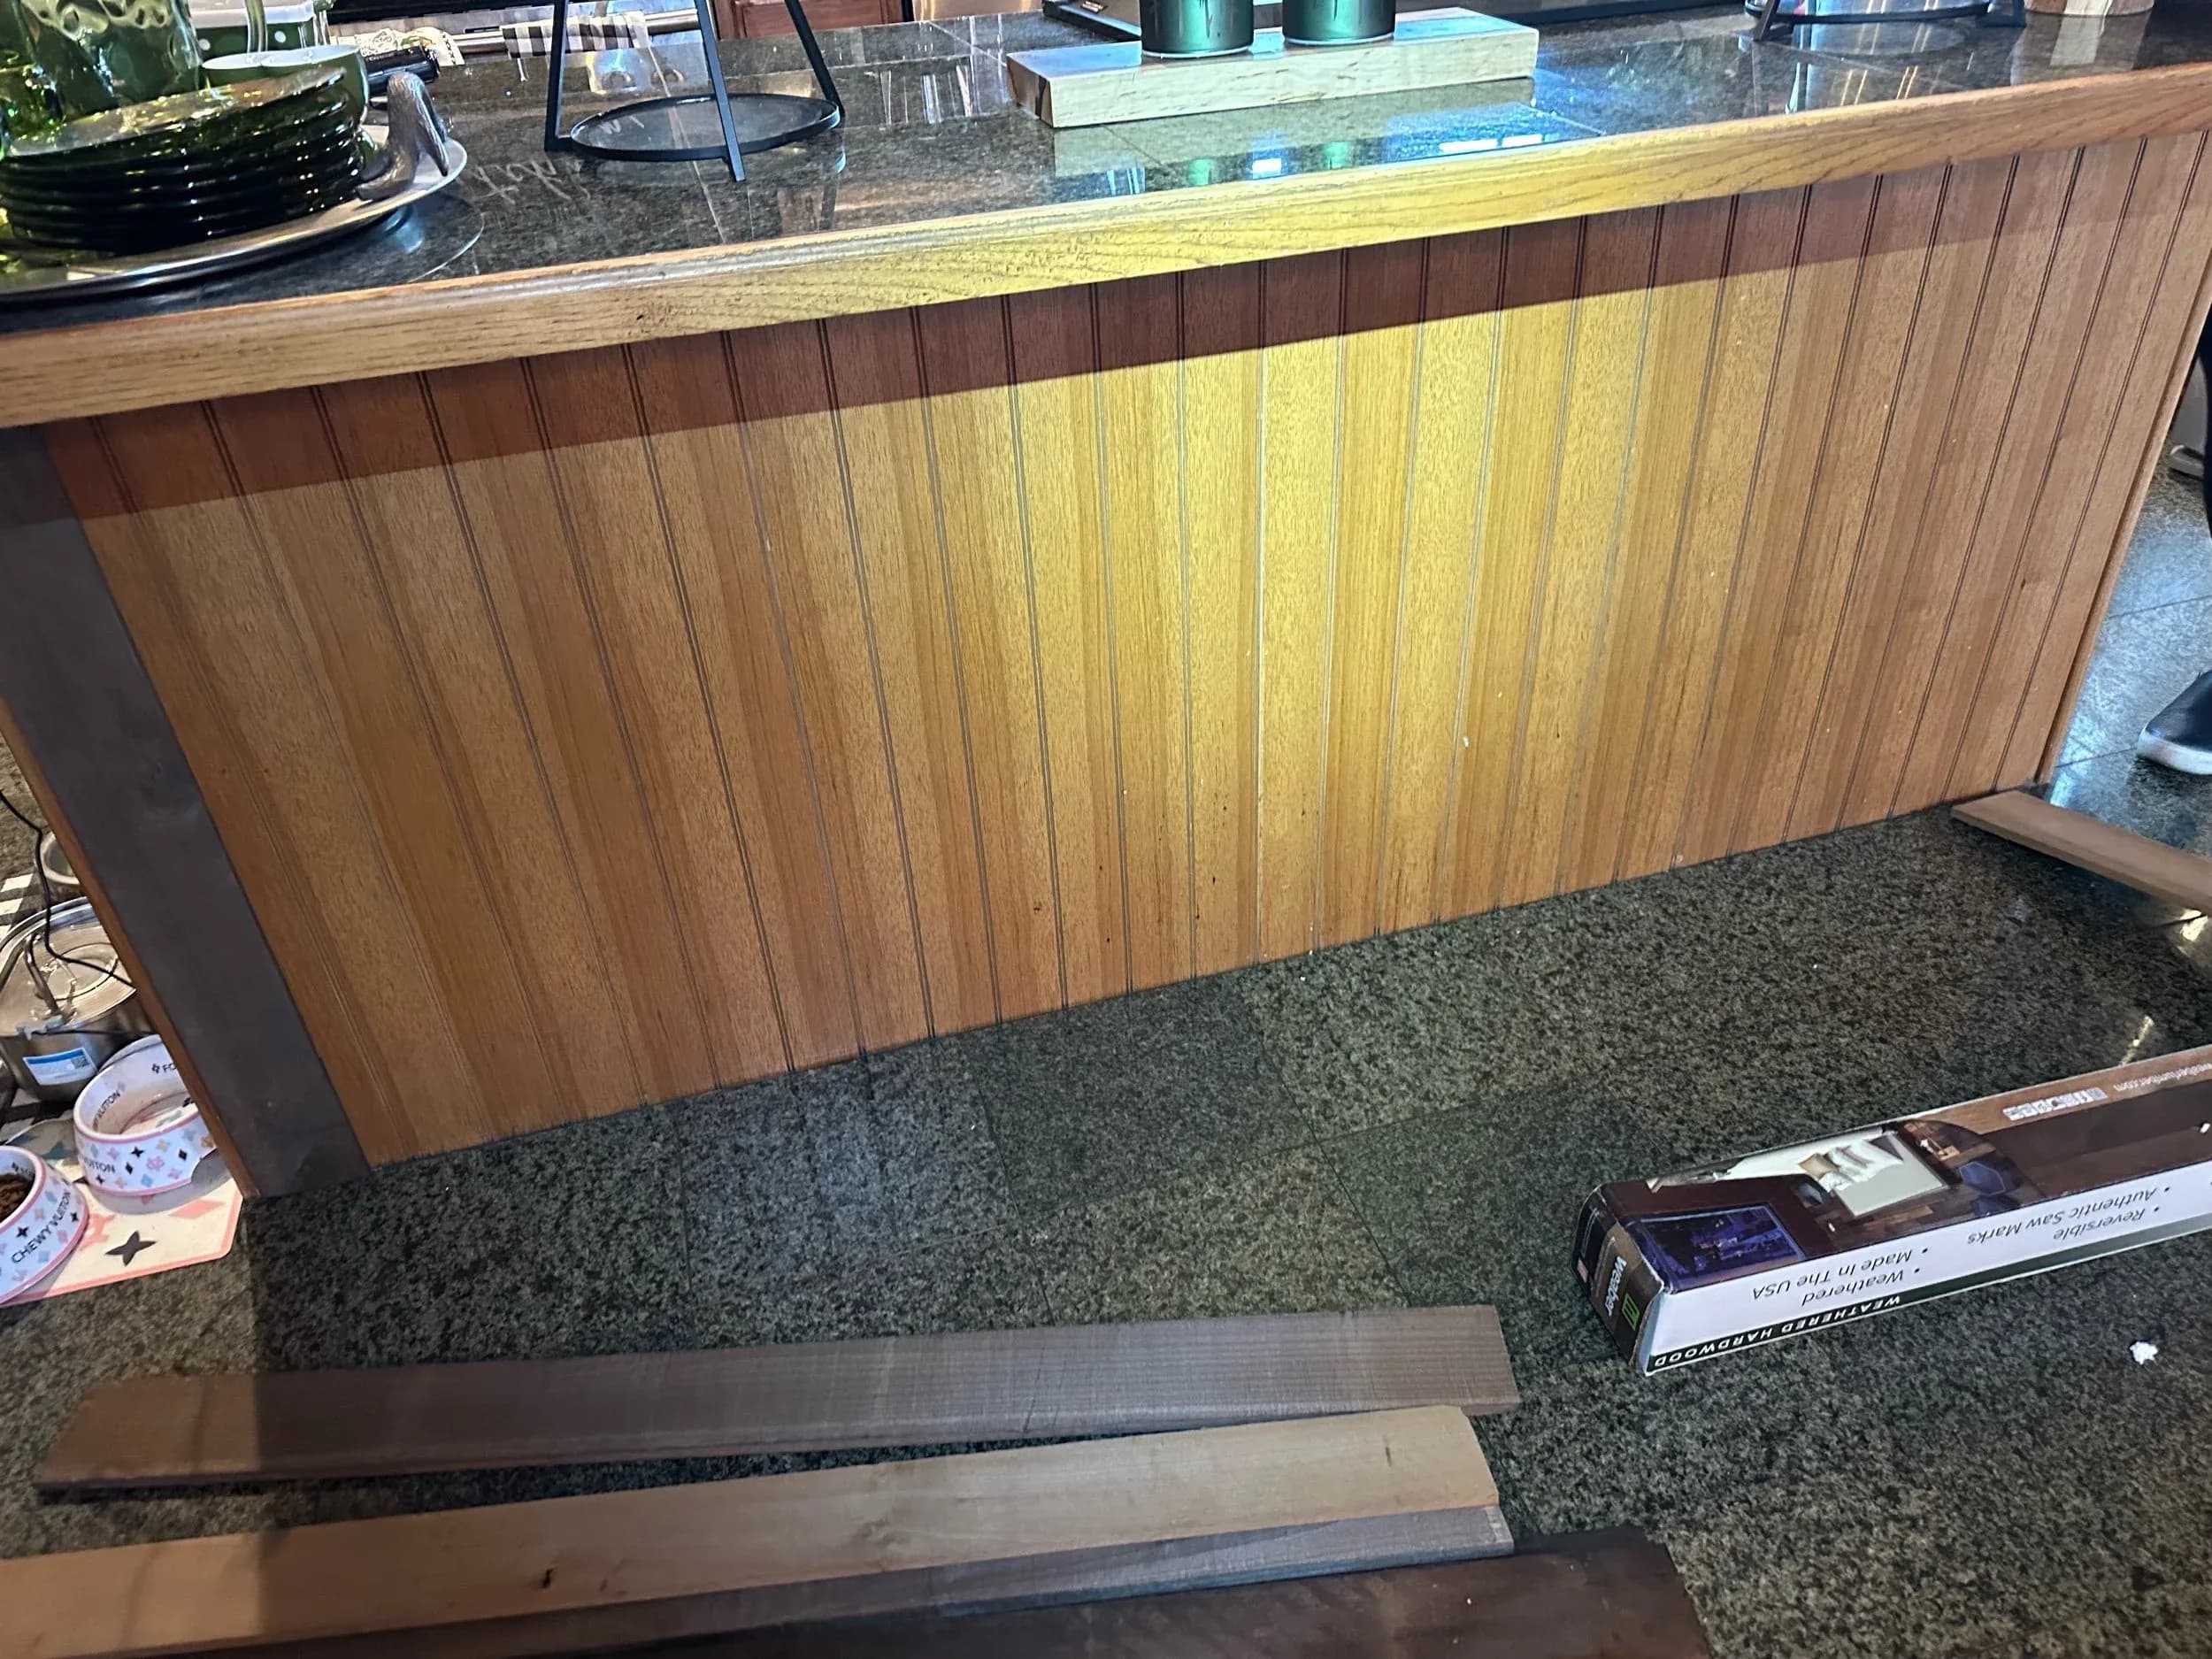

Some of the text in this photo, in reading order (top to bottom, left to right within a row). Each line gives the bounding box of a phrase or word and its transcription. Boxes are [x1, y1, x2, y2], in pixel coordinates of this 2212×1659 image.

[1967, 1187, 2158, 1245] Authentic Saw Marks
[2053, 1208, 2145, 1240] Reversible
[11, 1224, 51, 1263] CHEWY
[1605, 1256, 1627, 1317] weaber
[1753, 1249, 1912, 1300] Made In The USA
[1801, 1269, 1904, 1307] Weathered
[1654, 1296, 1901, 1367] WEATHERED HARDWOOD
